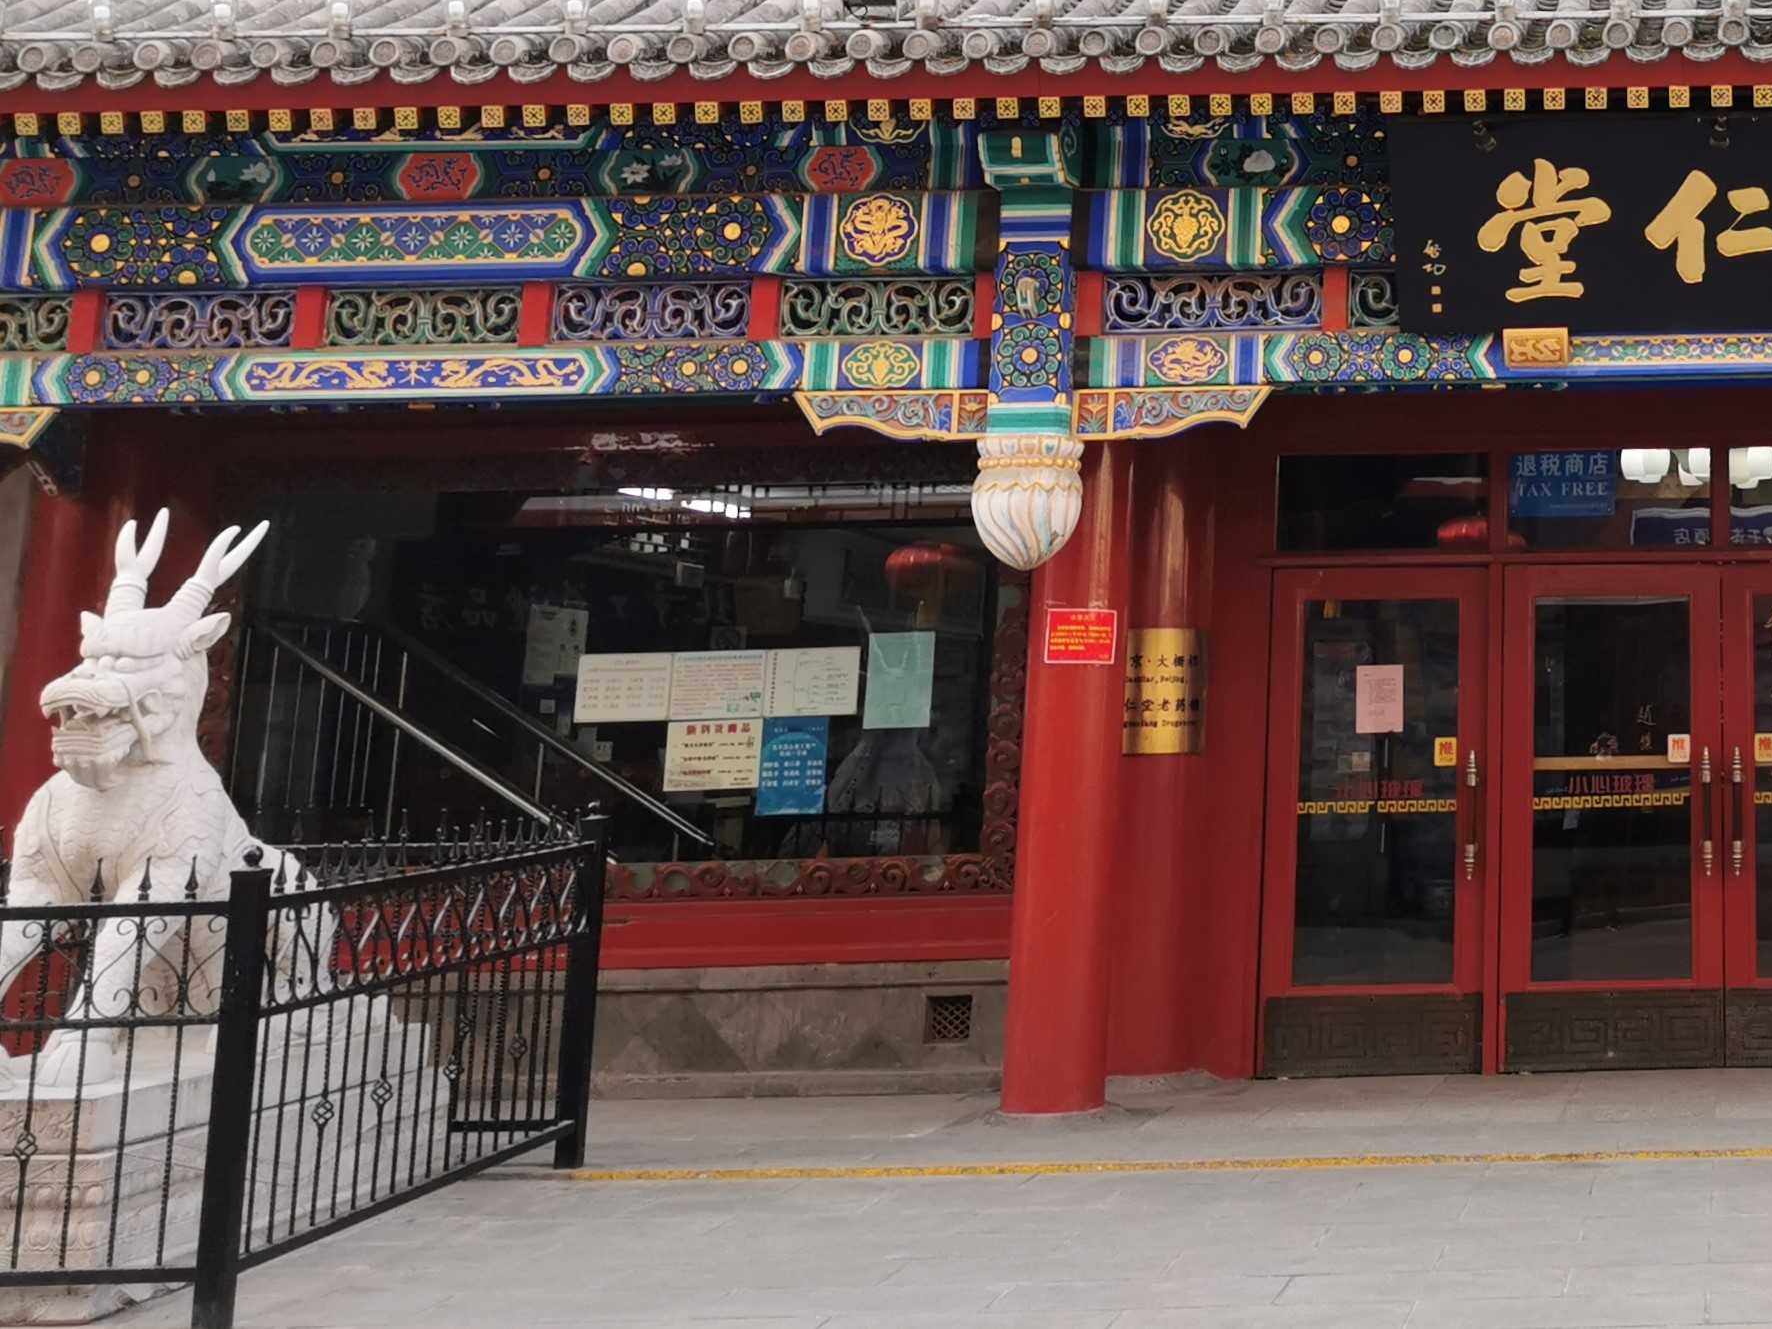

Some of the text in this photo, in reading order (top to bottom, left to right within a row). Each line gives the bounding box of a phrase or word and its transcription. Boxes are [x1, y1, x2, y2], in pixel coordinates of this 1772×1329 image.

[1516, 452, 1608, 477] 退税商店
[1519, 481, 1608, 497] TAX FREE
[1569, 774, 1654, 793] 小心玻璃
